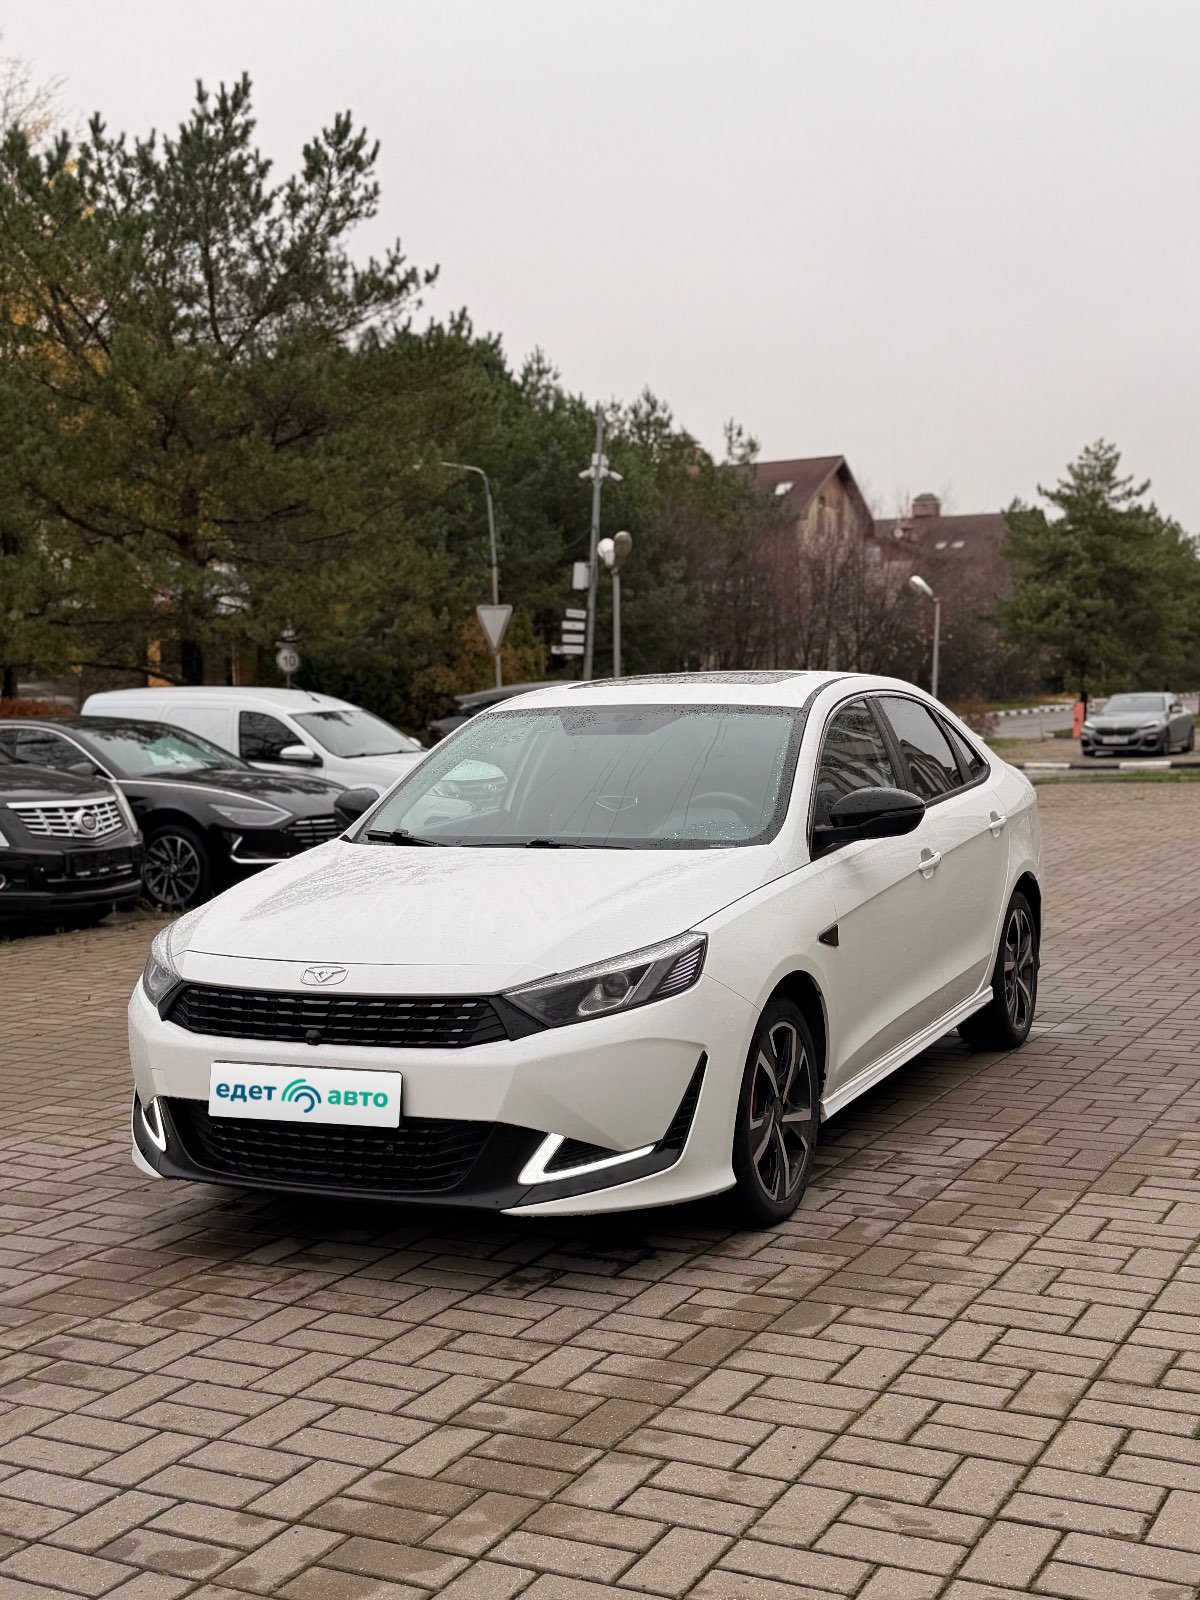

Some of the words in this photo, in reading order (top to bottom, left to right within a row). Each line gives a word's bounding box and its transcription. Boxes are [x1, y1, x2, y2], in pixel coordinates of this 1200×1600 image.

[282, 655, 297, 667] 10
[215, 1082, 277, 1102] едет
[327, 1089, 389, 1108] авто
